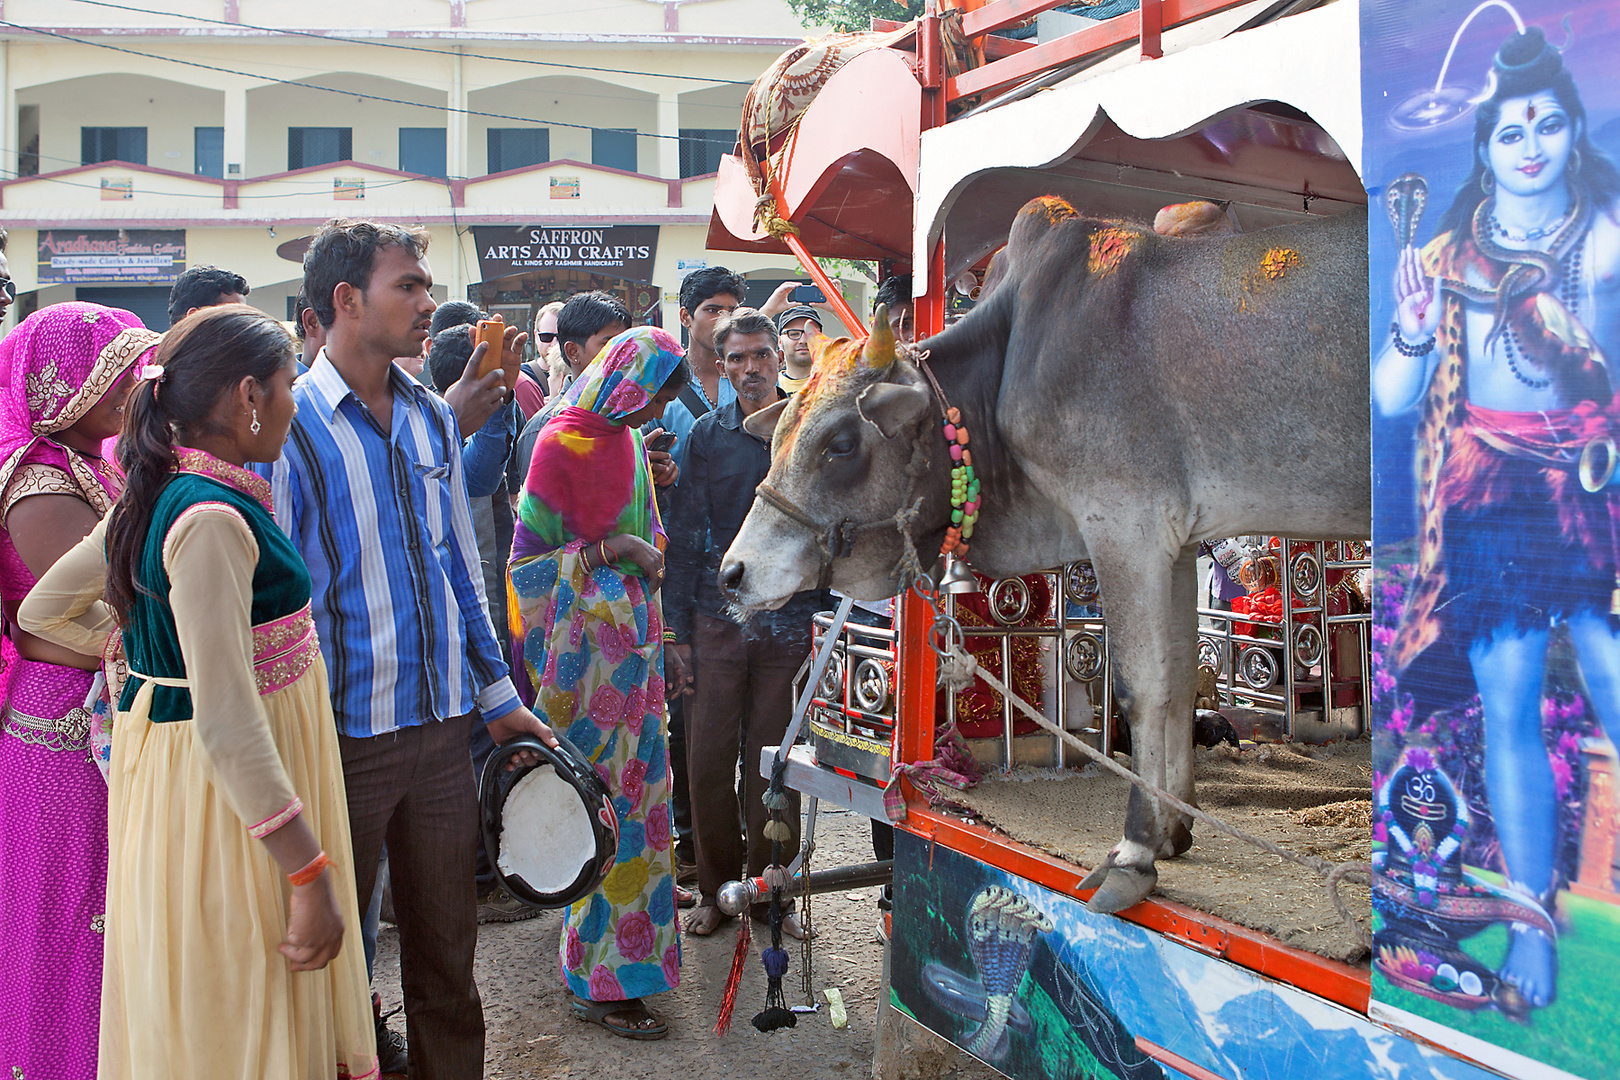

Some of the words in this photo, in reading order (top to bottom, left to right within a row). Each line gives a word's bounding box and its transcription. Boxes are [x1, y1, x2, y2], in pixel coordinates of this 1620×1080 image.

[38, 231, 117, 254] Aradhana
[530, 230, 604, 245] SAFFRON
[484, 245, 532, 259] ARTS
[536, 245, 571, 259] AND
[578, 245, 650, 259] CRAFTS
